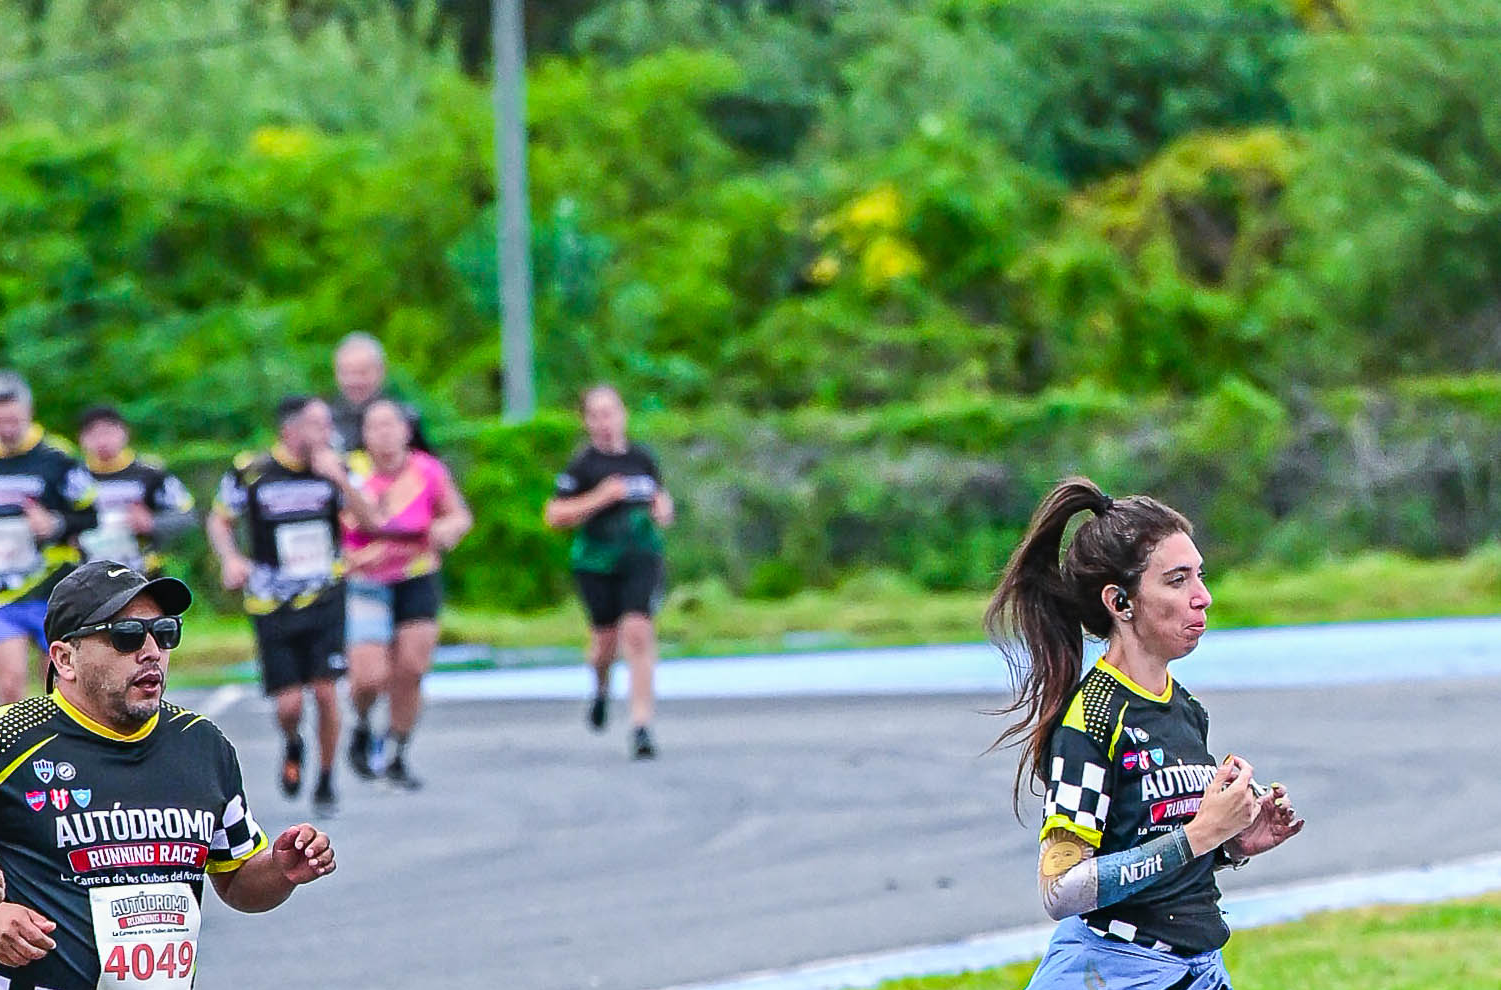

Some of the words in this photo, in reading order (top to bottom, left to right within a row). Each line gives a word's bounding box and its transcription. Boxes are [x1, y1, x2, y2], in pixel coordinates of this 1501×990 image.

[1141, 757, 1218, 802] AUTÓDRO
[55, 802, 215, 848] AUTÓDROMO
[86, 847, 154, 868] RUNNING
[159, 844, 200, 864] RACE
[113, 874, 125, 884] de
[110, 891, 190, 917] AUTÓDROMO
[104, 941, 194, 981] 4049
